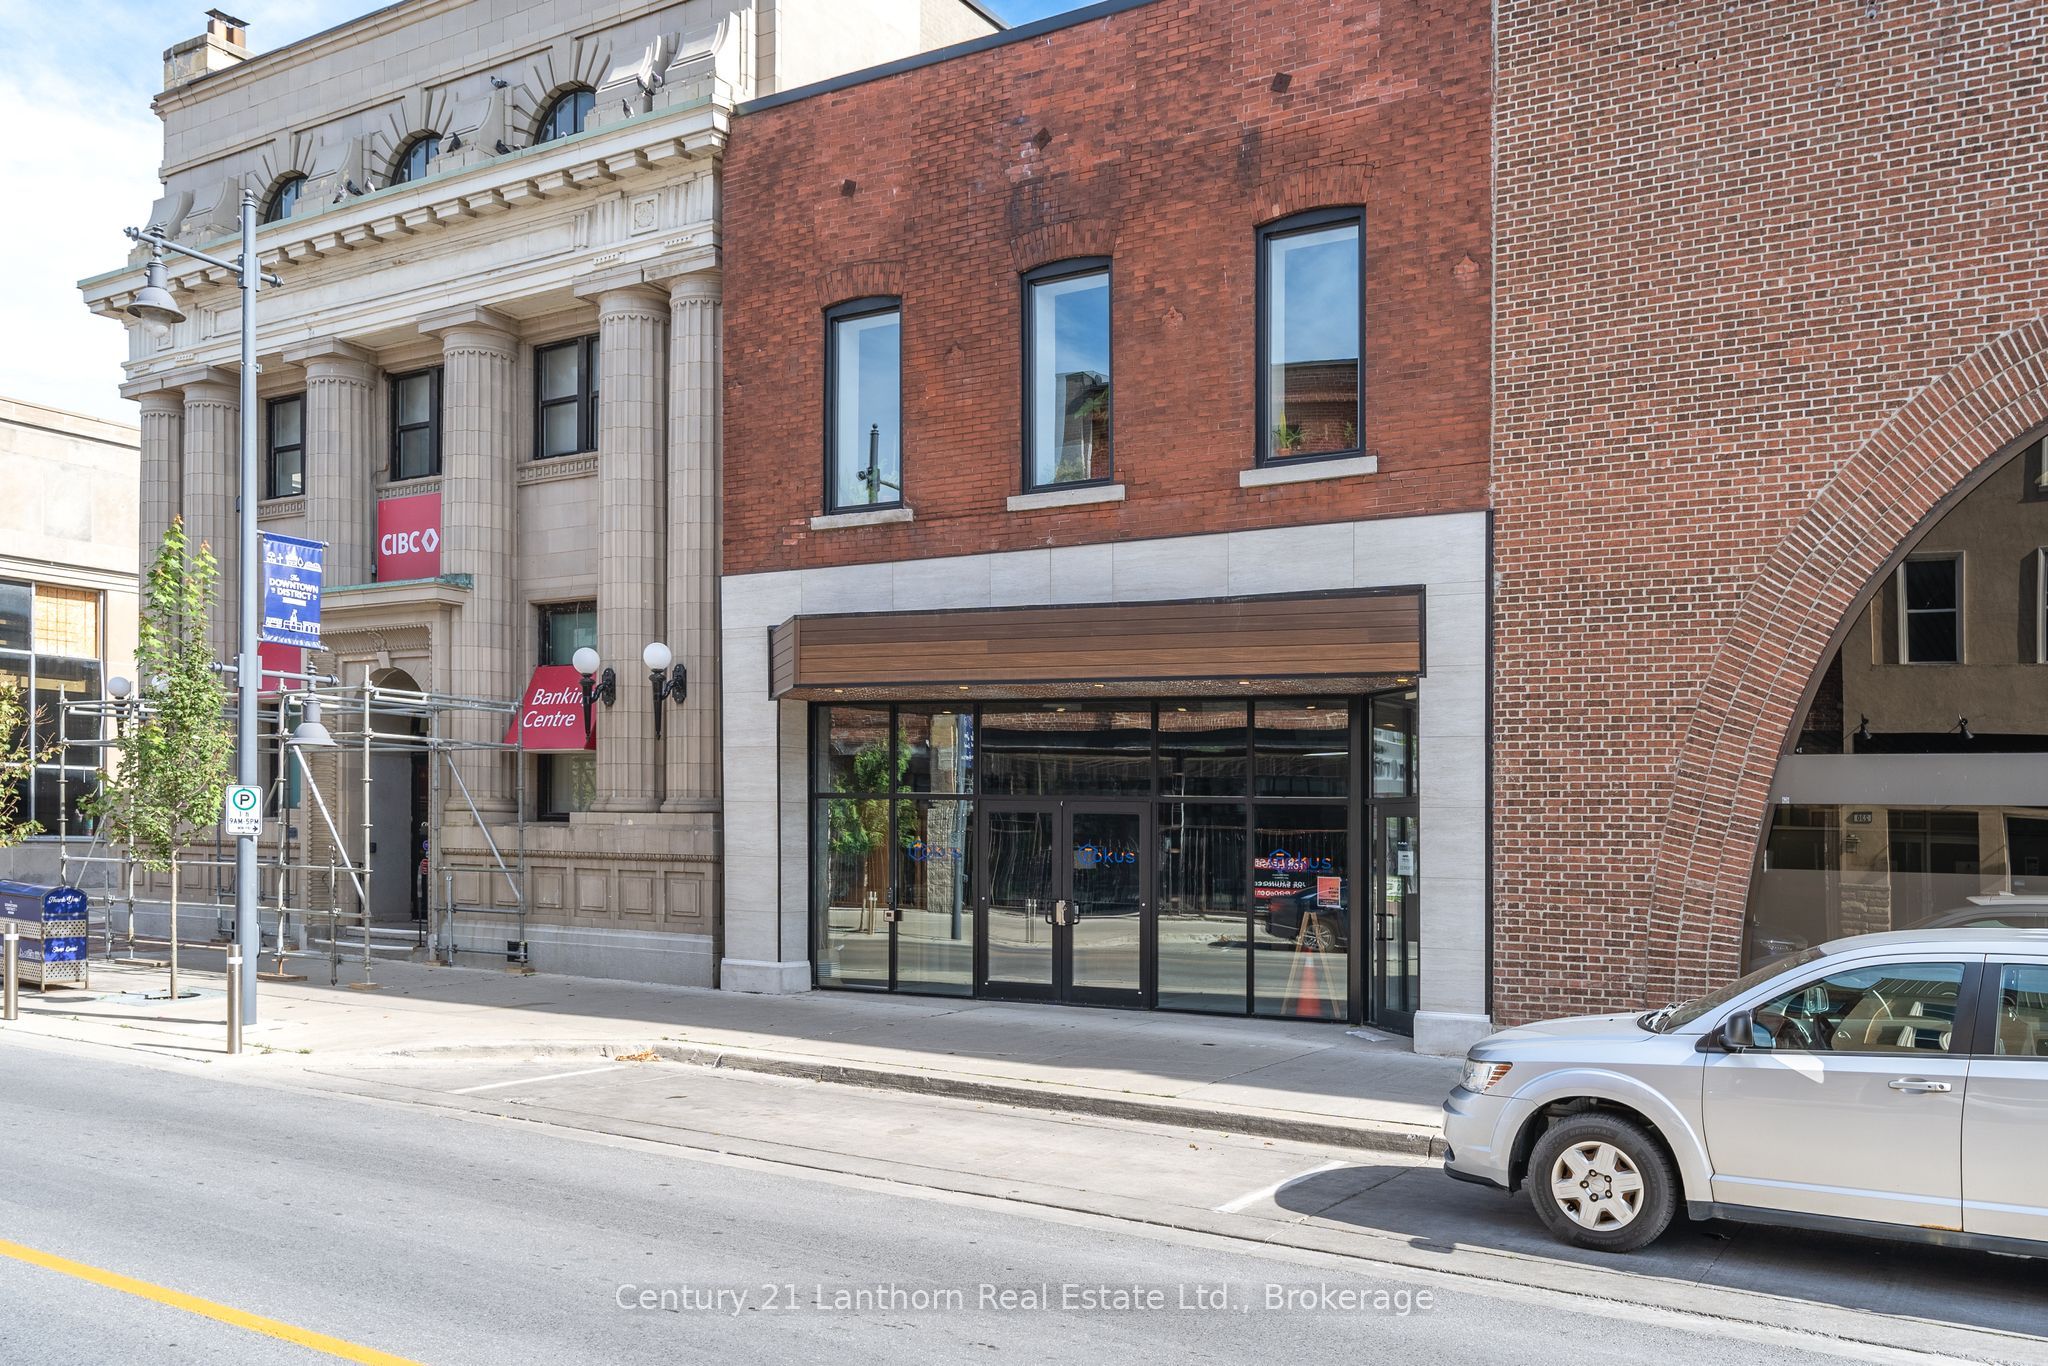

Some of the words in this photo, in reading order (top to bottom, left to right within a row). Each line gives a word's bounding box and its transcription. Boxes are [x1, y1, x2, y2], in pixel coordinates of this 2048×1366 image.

[381, 530, 420, 556] CIBC
[268, 577, 319, 594] DOWNTOWN
[277, 587, 311, 600] DISTRICT
[531, 687, 595, 707] Bankin
[523, 710, 576, 728] Centre
[240, 794, 250, 805] P
